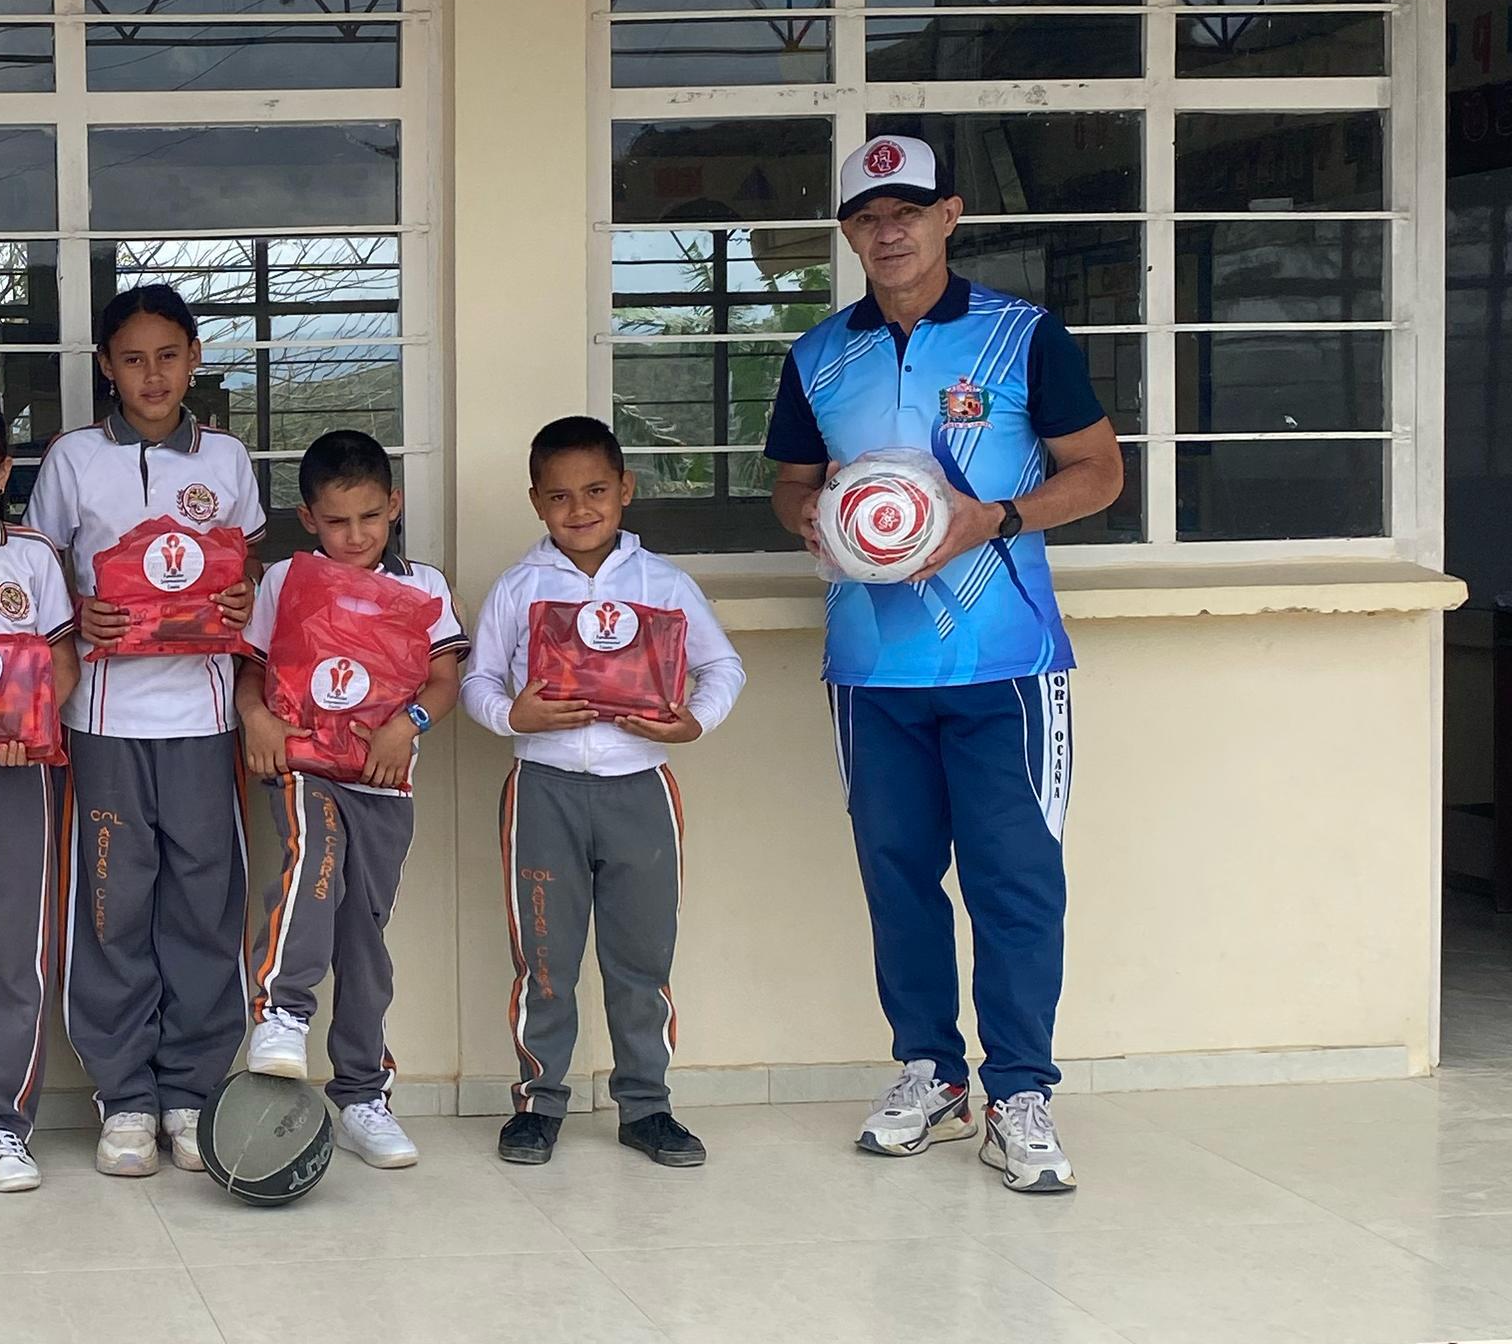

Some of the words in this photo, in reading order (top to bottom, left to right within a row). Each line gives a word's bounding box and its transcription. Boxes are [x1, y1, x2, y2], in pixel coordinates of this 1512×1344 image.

[1053, 669, 1066, 715] ORT
[1054, 730, 1065, 799] OCAÑA
[96, 826, 111, 879] AGUAS
[520, 868, 556, 882] COL
